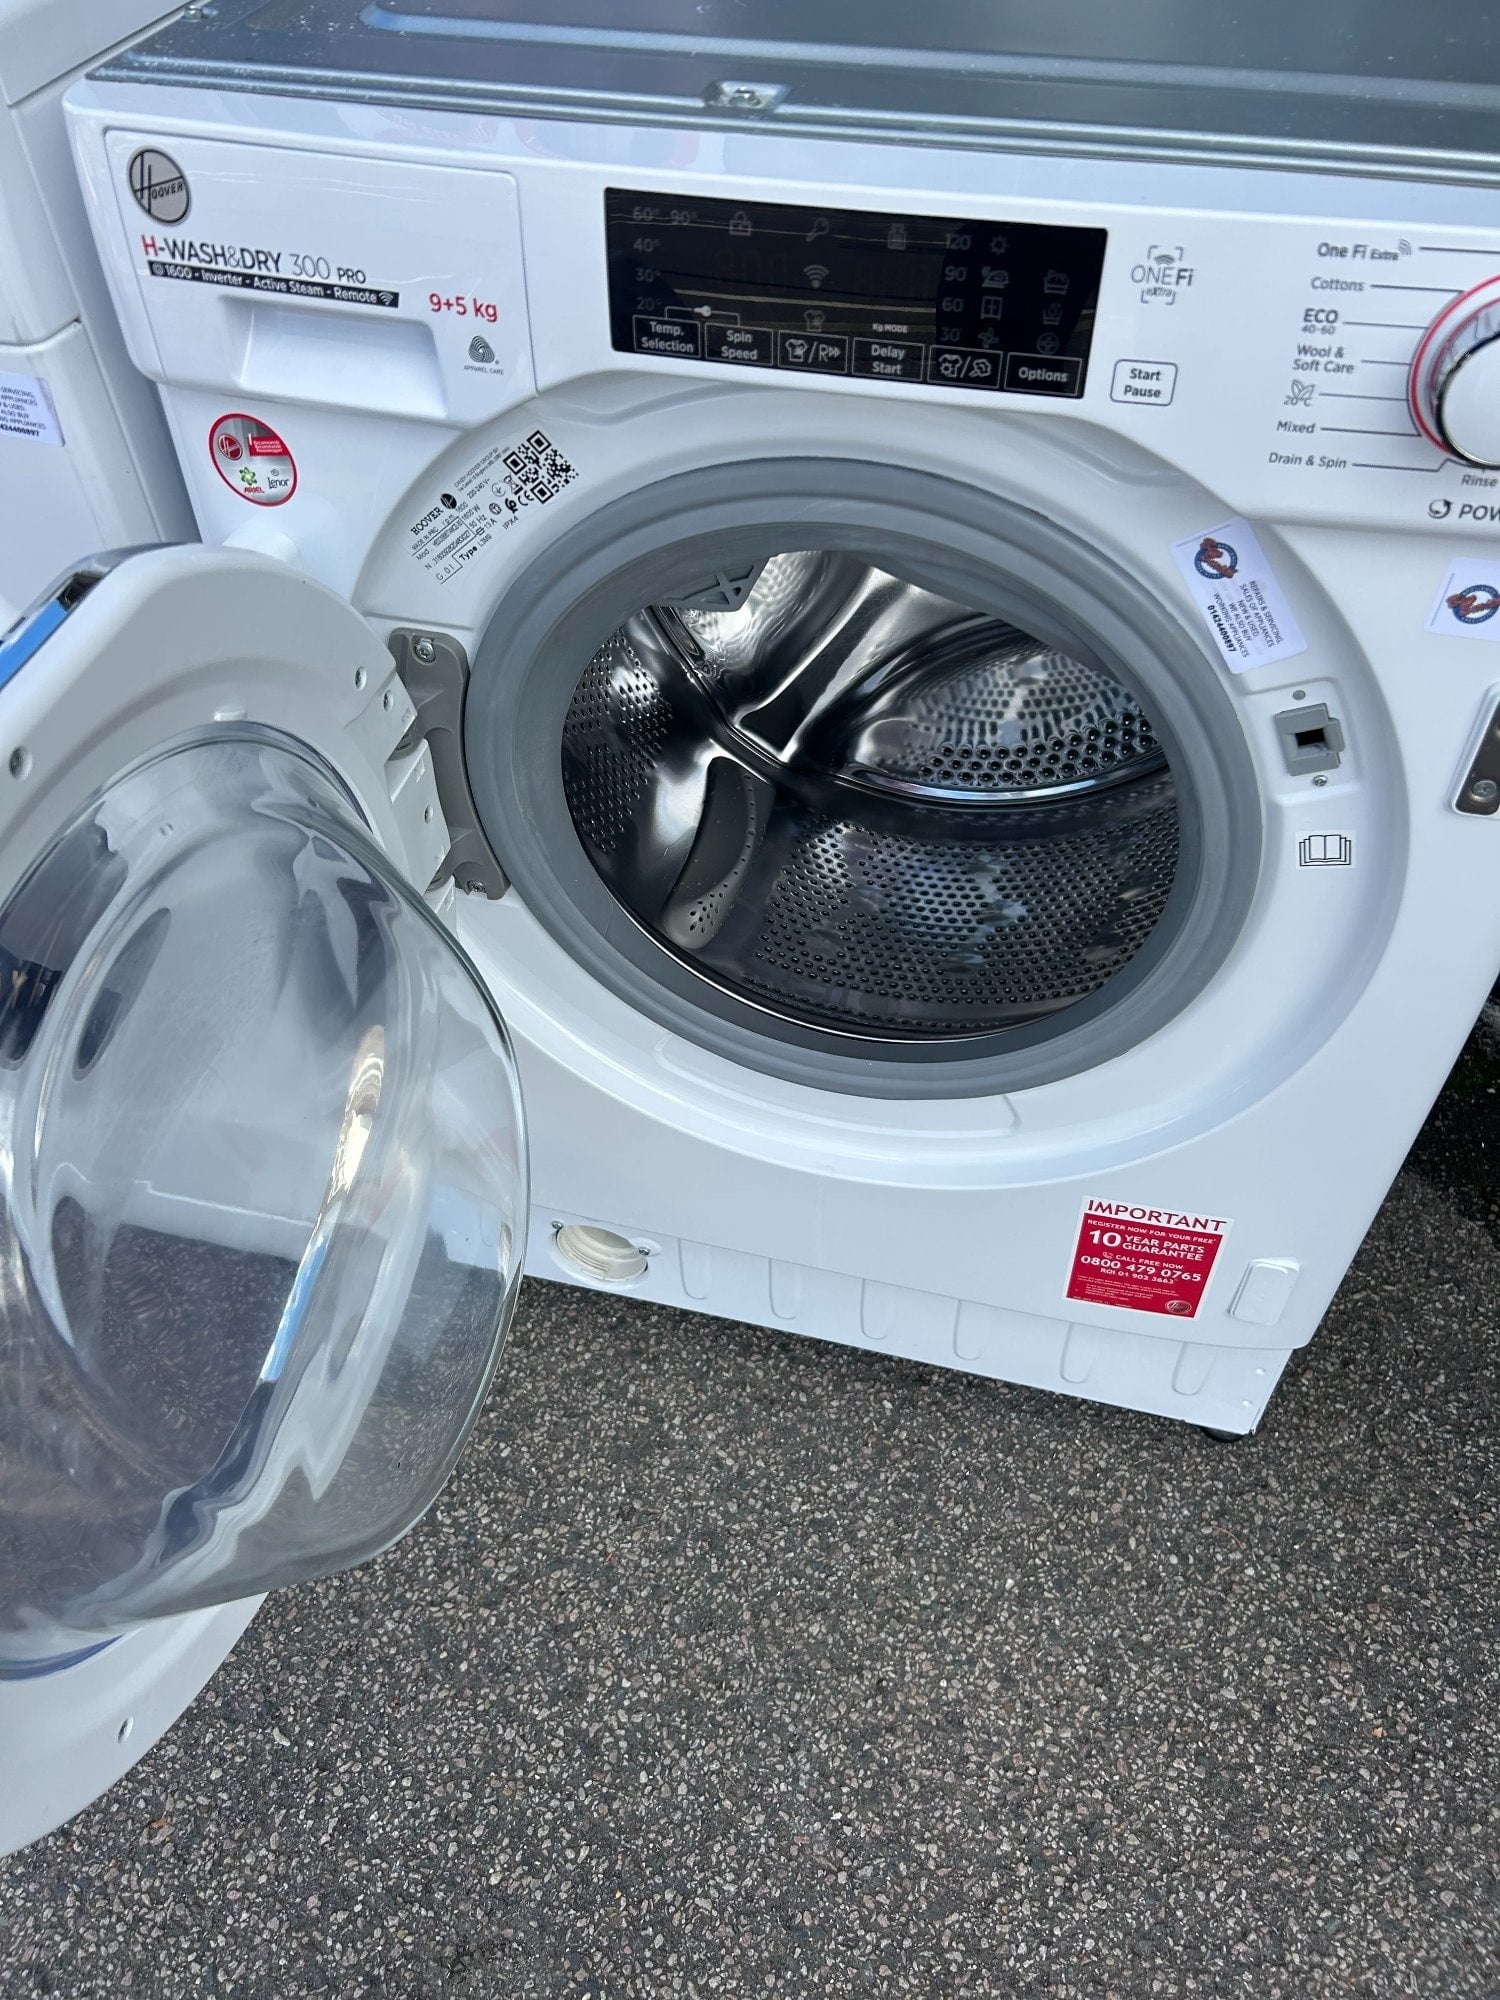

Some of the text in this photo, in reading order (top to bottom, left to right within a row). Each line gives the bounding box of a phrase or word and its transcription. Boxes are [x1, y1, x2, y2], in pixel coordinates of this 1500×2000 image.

[141, 234, 367, 285] H-WASH&DRY 300 PRO
[1317, 242, 1400, 261] One Fi Extra
[165, 264, 192, 280] 1600
[202, 268, 243, 287] Inverter
[253, 277, 288, 294] Active
[288, 281, 325, 298] Steam
[333, 285, 378, 304] Remote
[1310, 276, 1367, 293] Cottons
[429, 293, 499, 323] 9+5 kg
[1303, 307, 1340, 324] ECO
[649, 321, 685, 337] Temp.
[726, 329, 753, 344] Spin
[872, 323, 908, 333] Kg MODE
[1301, 324, 1337, 335] 40-60
[641, 336, 695, 354] Selection
[721, 345, 758, 361] Speed
[871, 344, 906, 360] Delay
[1297, 344, 1345, 359] Wool &
[489, 367, 504, 376] CARE
[872, 360, 904, 375] Start
[1018, 366, 1069, 383] Options
[1129, 367, 1162, 382] Start
[1293, 358, 1355, 375] Soft Care
[1123, 384, 1162, 399] Pause
[1276, 420, 1315, 434] Mixed
[1268, 451, 1348, 470] Drain & Spin
[267, 477, 289, 490] Lenor
[1461, 473, 1498, 488] Rinse
[410, 506, 444, 536] HOOVER
[476, 514, 487, 524] Hz
[502, 515, 519, 530] IPX4
[459, 546, 478, 562] Type
[1249, 581, 1266, 606] REPAIRS
[1237, 600, 1249, 614] NEW
[1214, 592, 1250, 657] WORKING APPLIANCES
[1240, 584, 1254, 602] SALES
[1254, 612, 1275, 648] APPLIANCES
[1208, 604, 1237, 651] 01424400897
[1234, 613, 1245, 629] ALSO
[1242, 629, 1252, 640] BUY
[1088, 1200, 1227, 1232] IMPORTANT
[1087, 1219, 1126, 1230] REGISTER
[1149, 1229, 1166, 1237] FOR
[1168, 1232, 1191, 1241] YOUR
[1089, 1229, 1205, 1254] 10 YEAR PARTS
[1122, 1242, 1204, 1261] GUARANTEE
[1080, 1255, 1202, 1282] 0800 479 0765
[1115, 1254, 1184, 1270] CALL FREE NOW
[1100, 1267, 1175, 1285] ROI 01 902 3663
